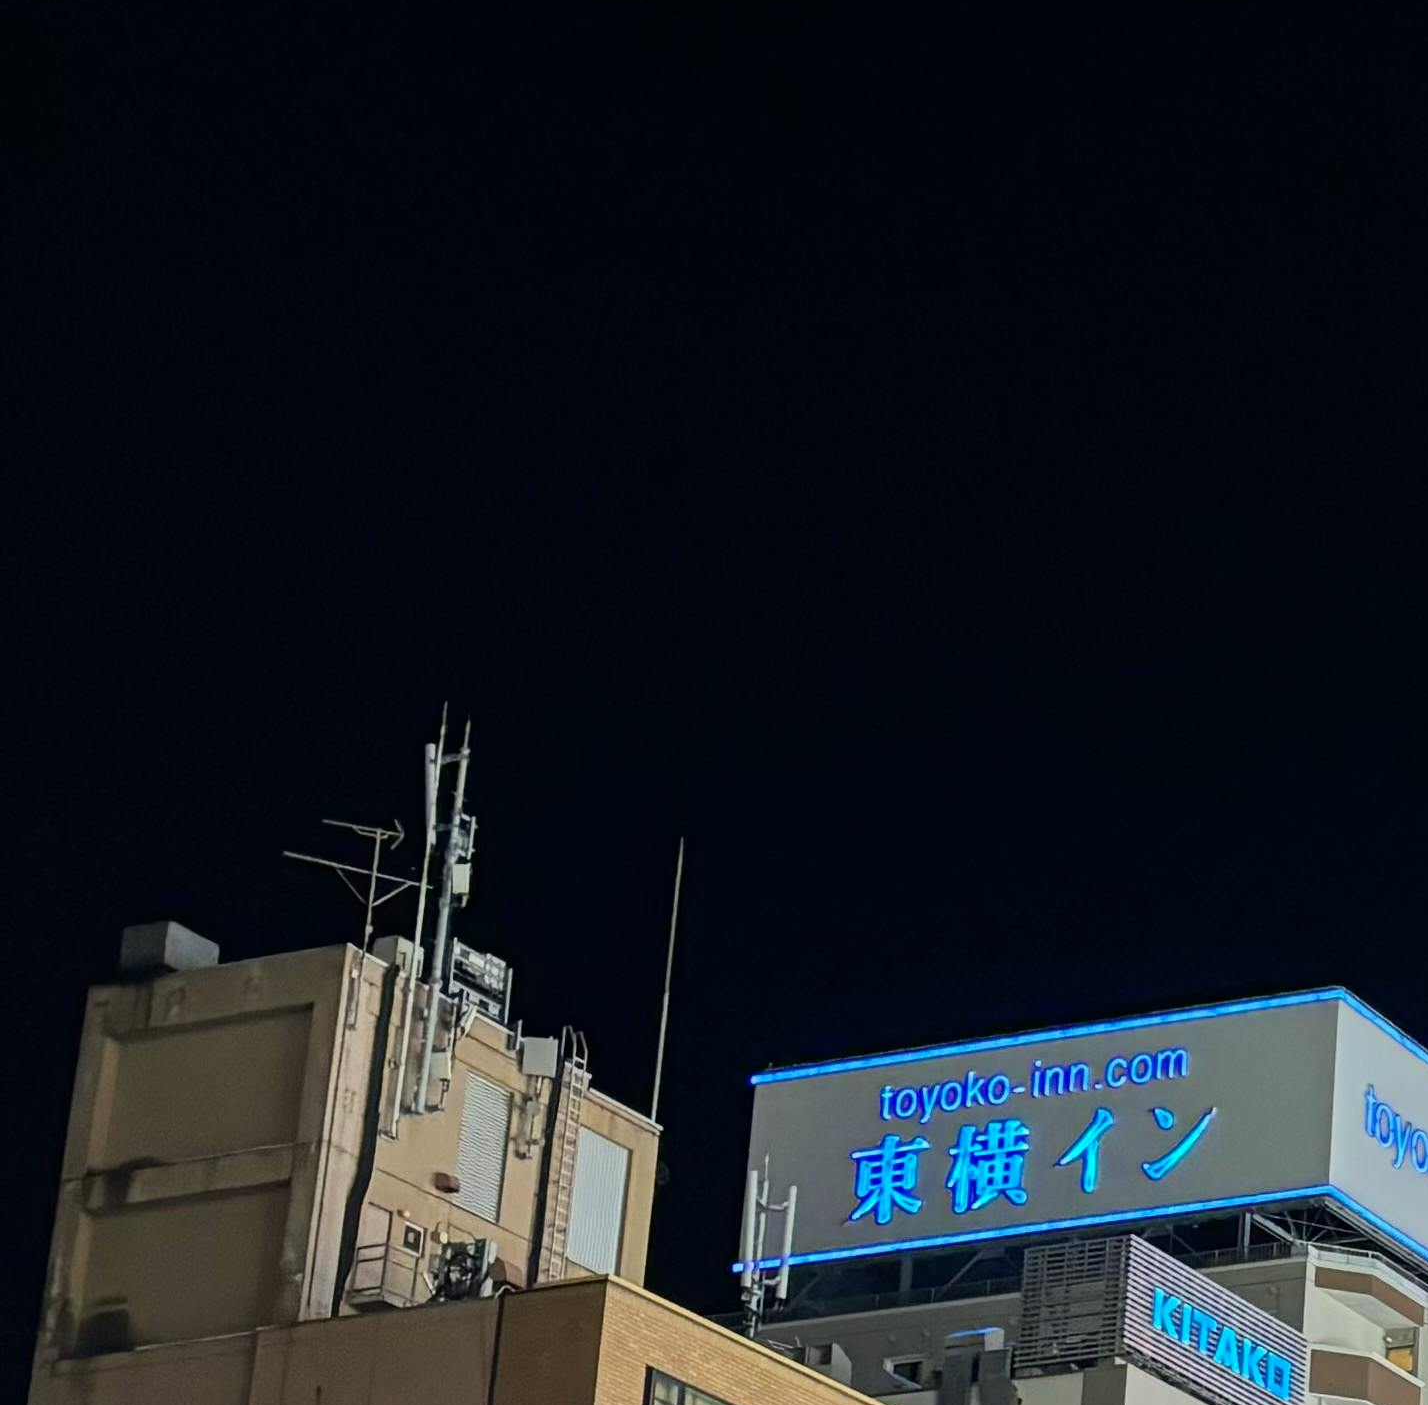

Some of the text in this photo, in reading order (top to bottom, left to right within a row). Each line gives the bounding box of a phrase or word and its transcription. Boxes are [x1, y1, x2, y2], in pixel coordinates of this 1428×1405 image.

[880, 1046, 1190, 1123] toyoko-inn.com
[846, 1105, 1218, 1225] 東横イン
[1152, 1287, 1293, 1401] KITAKO
